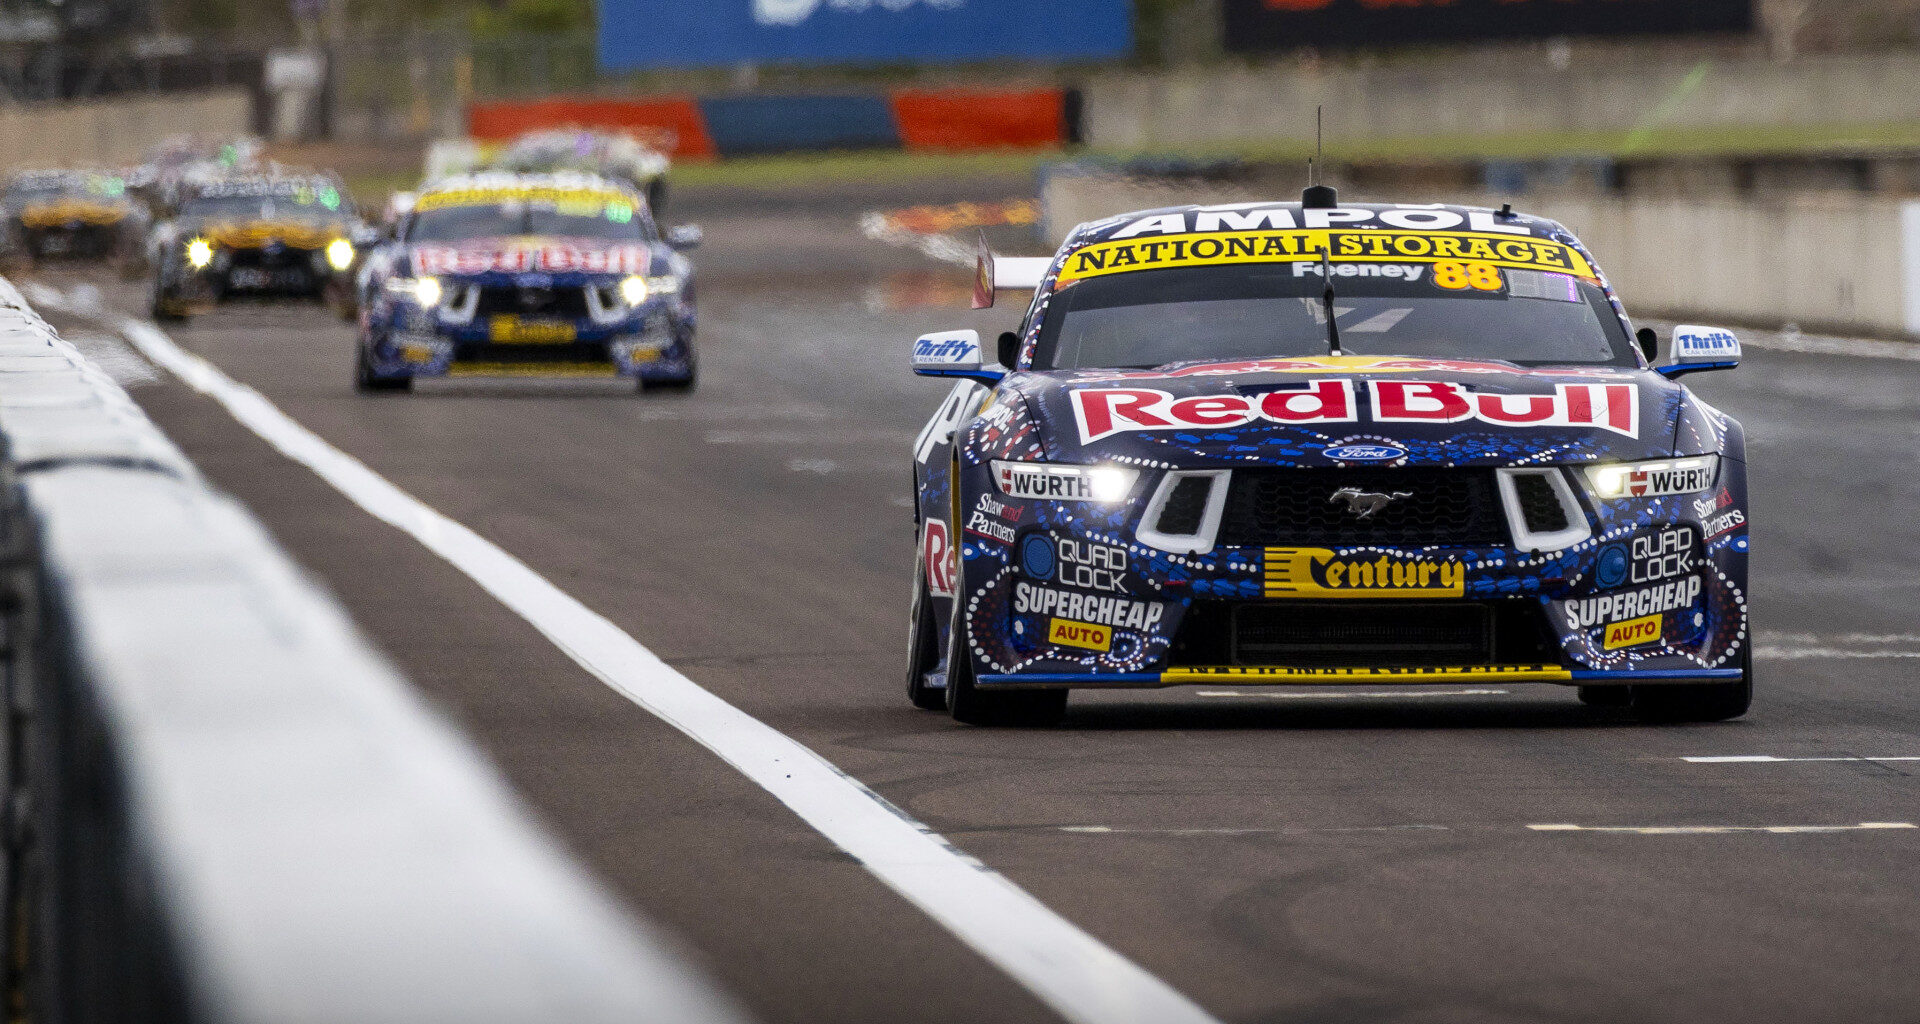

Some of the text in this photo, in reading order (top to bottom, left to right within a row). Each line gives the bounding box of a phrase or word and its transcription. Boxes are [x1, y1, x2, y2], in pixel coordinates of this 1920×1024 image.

[1109, 208, 1530, 239] AMPOL
[1075, 234, 1564, 273] NATIONAL STORAGE
[1292, 261, 1503, 291] Feeney 88
[914, 339, 978, 362] Thrifty
[1075, 380, 1635, 441] Red Bull
[1013, 473, 1094, 498] WÜRTH
[1652, 467, 1711, 493] WÜRTH
[966, 510, 1015, 543] Partners
[1059, 538, 1127, 571] QUAD
[1632, 527, 1692, 560] QUAD
[1059, 562, 1129, 593] LOCK
[1290, 547, 1464, 594] Century
[1631, 550, 1691, 584] LOCK
[1014, 582, 1164, 632] SUPERCHEAP
[1564, 575, 1701, 630] SUPERCHEAP
[1055, 625, 1105, 645] AUTO
[1610, 621, 1656, 644] AUTO
